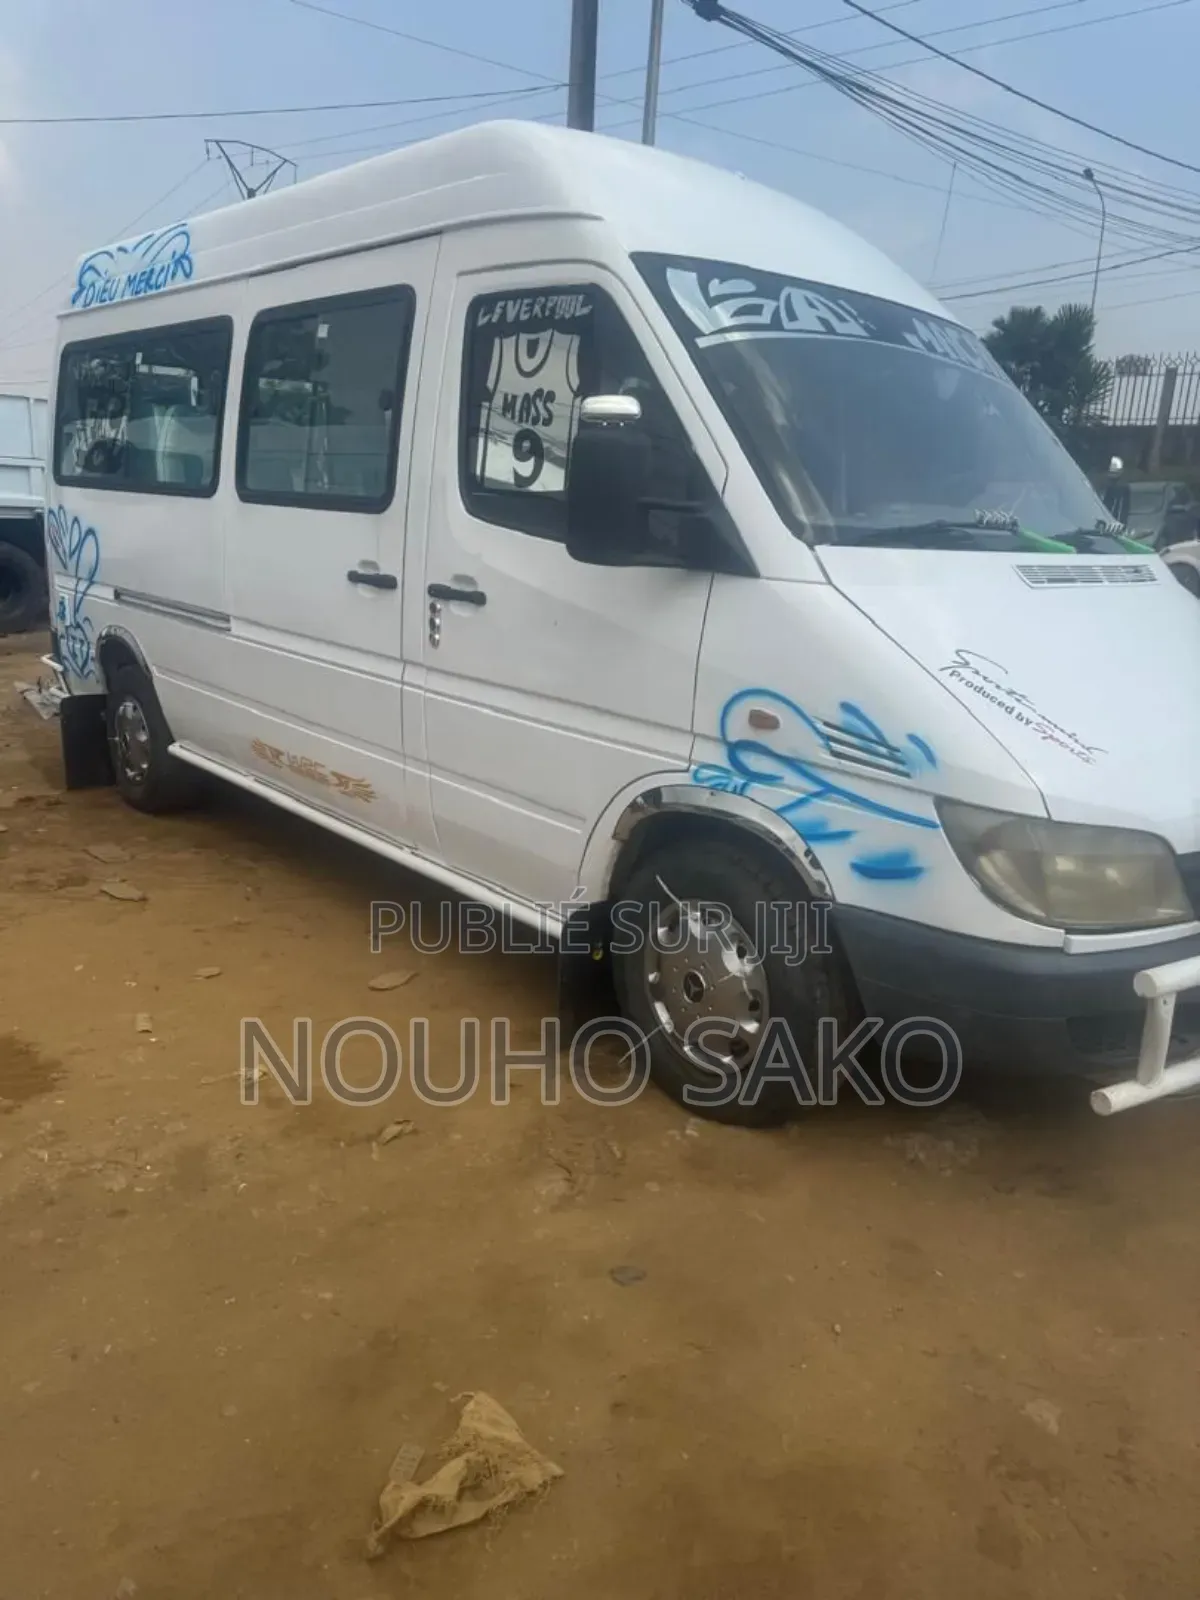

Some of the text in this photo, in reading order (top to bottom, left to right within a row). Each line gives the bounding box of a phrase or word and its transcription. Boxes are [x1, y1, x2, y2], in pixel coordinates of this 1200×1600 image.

[120, 262, 170, 299] MERCI
[502, 388, 556, 427] MASS
[512, 428, 545, 488] 9
[949, 669, 1097, 765] Produced by Sports
